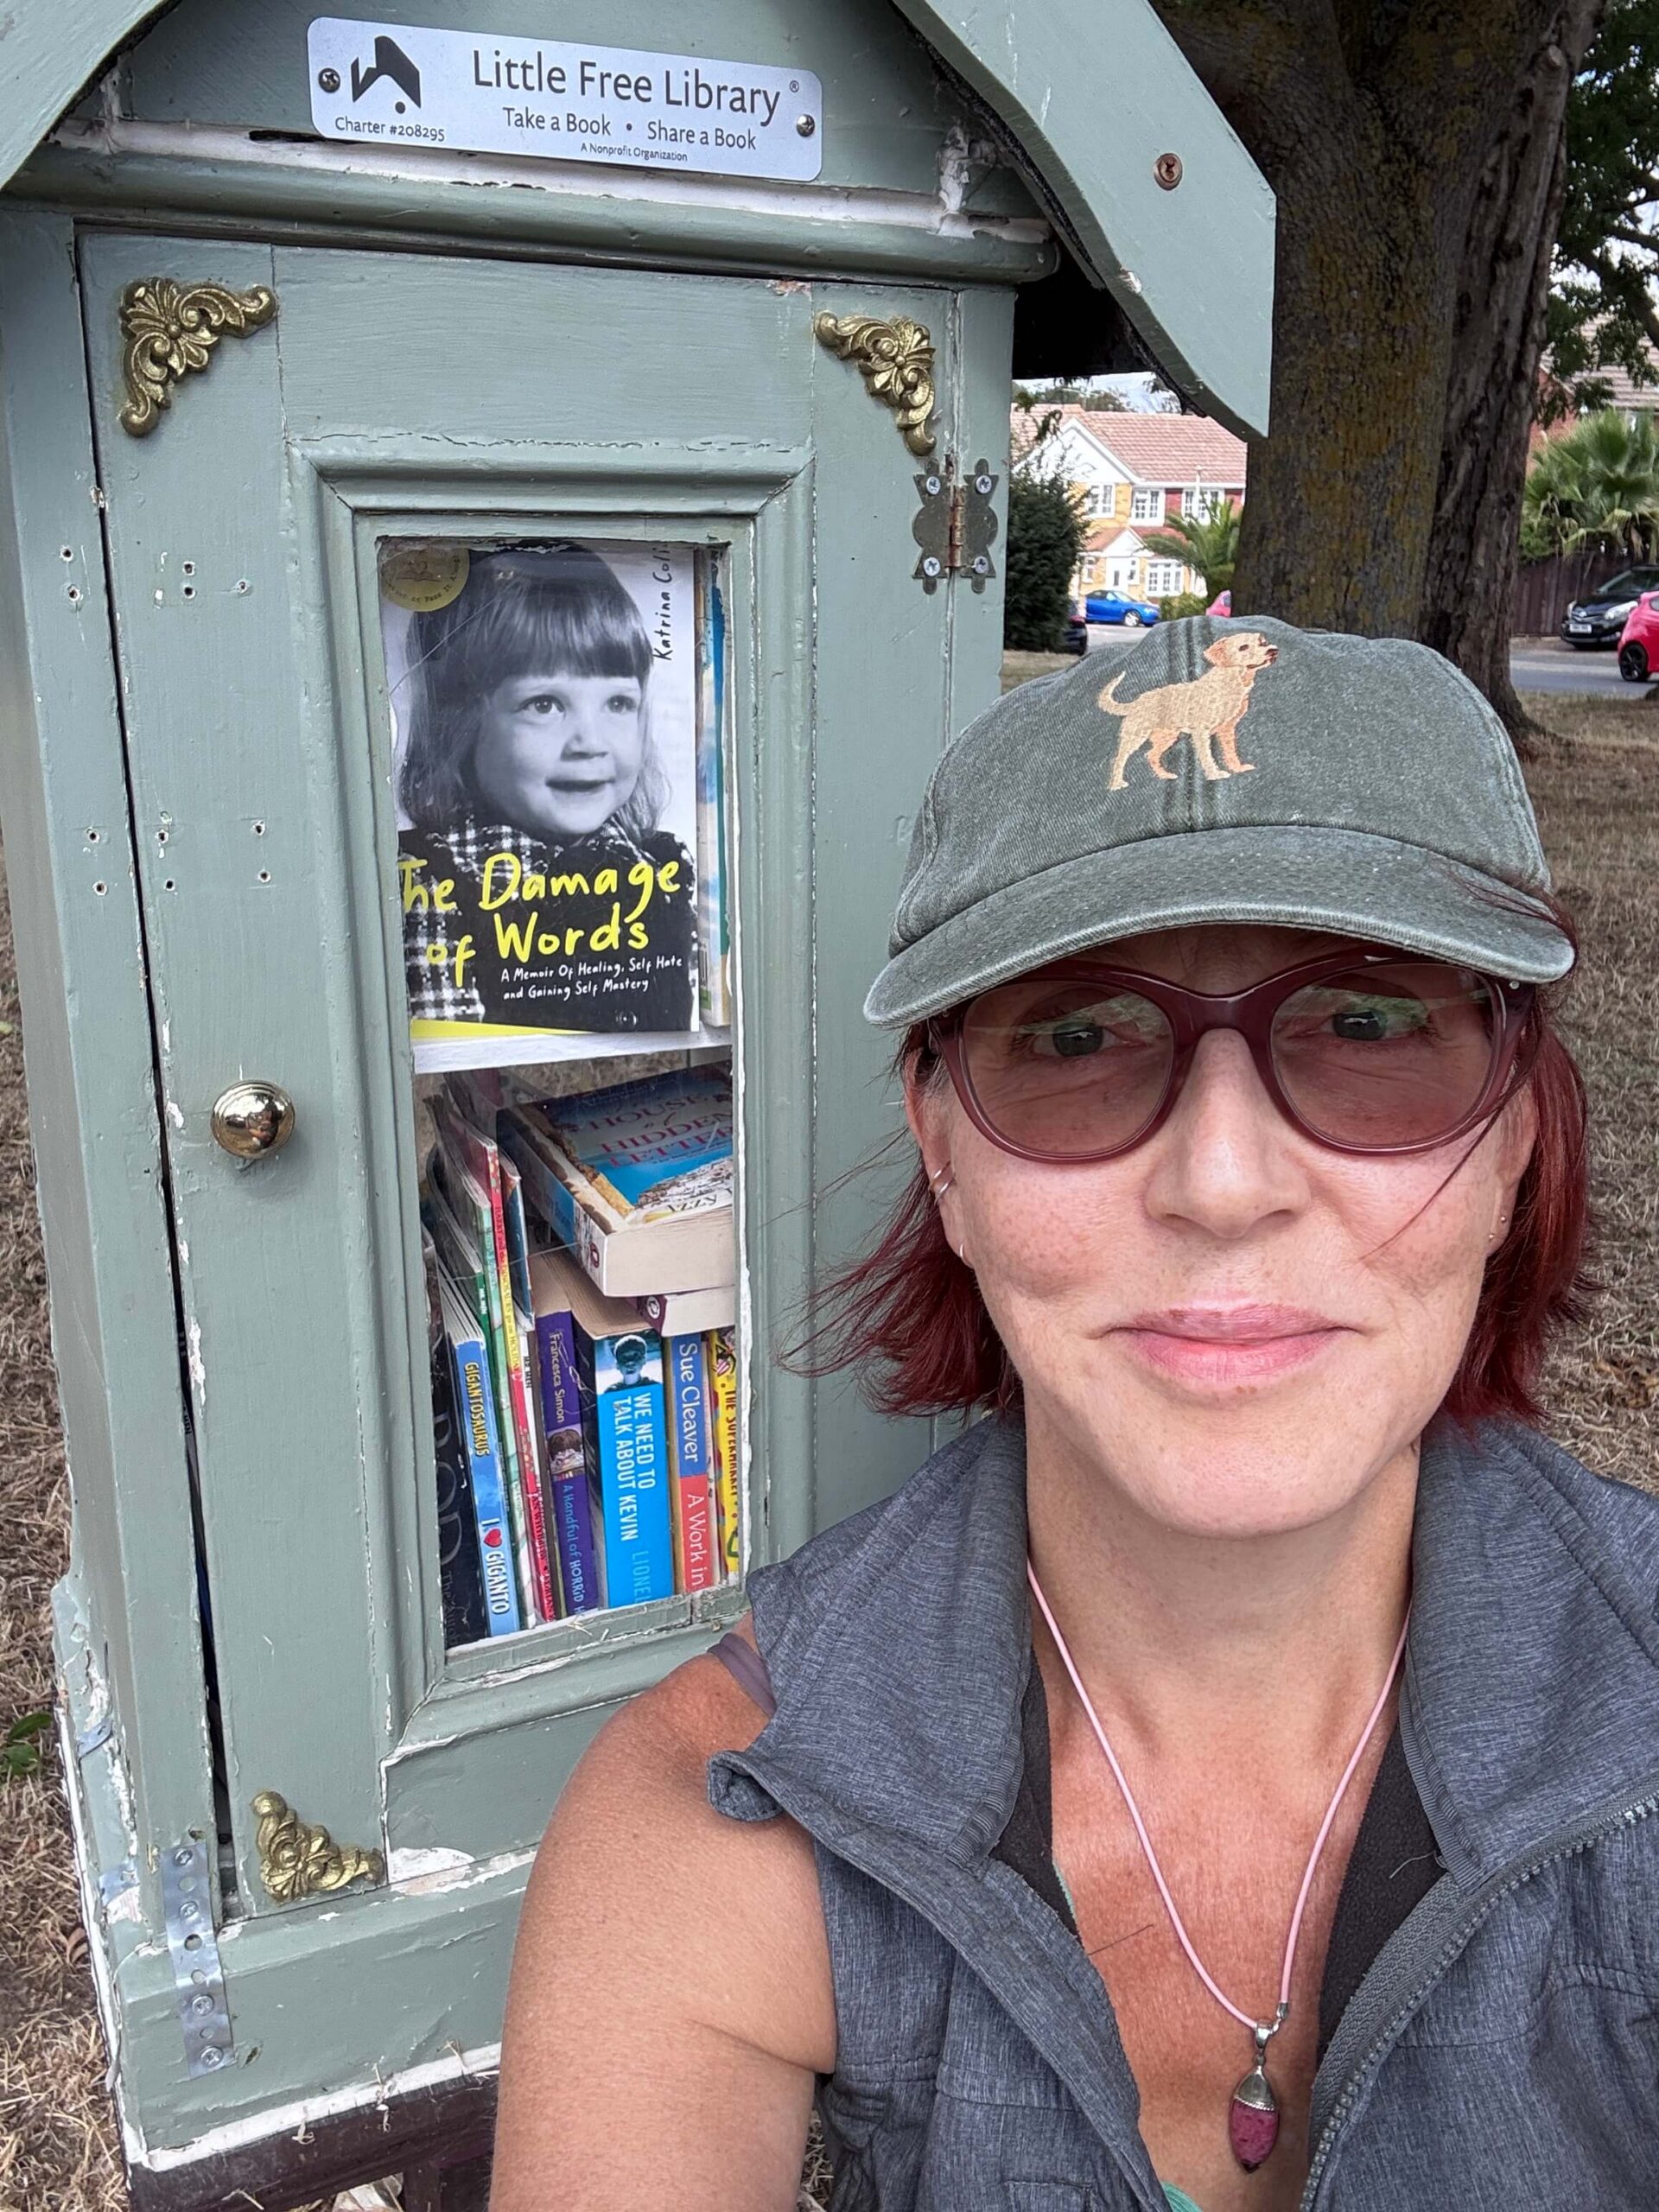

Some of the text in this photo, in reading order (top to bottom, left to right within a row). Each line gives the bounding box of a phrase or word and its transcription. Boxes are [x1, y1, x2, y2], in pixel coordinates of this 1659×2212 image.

[474, 49, 780, 127] Little Free Library
[334, 116, 445, 142] Charter #208295
[502, 106, 757, 150] Take a Book Share a Book
[581, 143, 688, 162] A Nonprofit Organization
[652, 591, 673, 661] Katrina
[398, 851, 682, 924] The Damage
[425, 901, 650, 988] of Words
[501, 967, 510, 982] A
[513, 965, 555, 982] Memoir
[559, 963, 575, 978] Of
[628, 958, 653, 973] Self
[656, 955, 683, 970] Hate
[503, 977, 650, 1001] and Gaining Self Mastery
[601, 1113, 733, 1153] HIDDEN
[464, 1361, 491, 1458] GIGANTOSAURUS
[549, 1333, 565, 1424] Francesca Simon
[679, 1343, 701, 1464] Sue Cleaver
[724, 1390, 737, 1412] THE
[614, 1395, 639, 1542] TALK ABOUT KEVIN
[633, 1392, 656, 1490] WE NEED TO
[563, 1484, 573, 1493] A
[563, 1497, 579, 1544] Handful
[480, 1517, 511, 1616] I GIGANTO
[567, 1546, 581, 1557] of
[687, 1493, 709, 1586] A Work in
